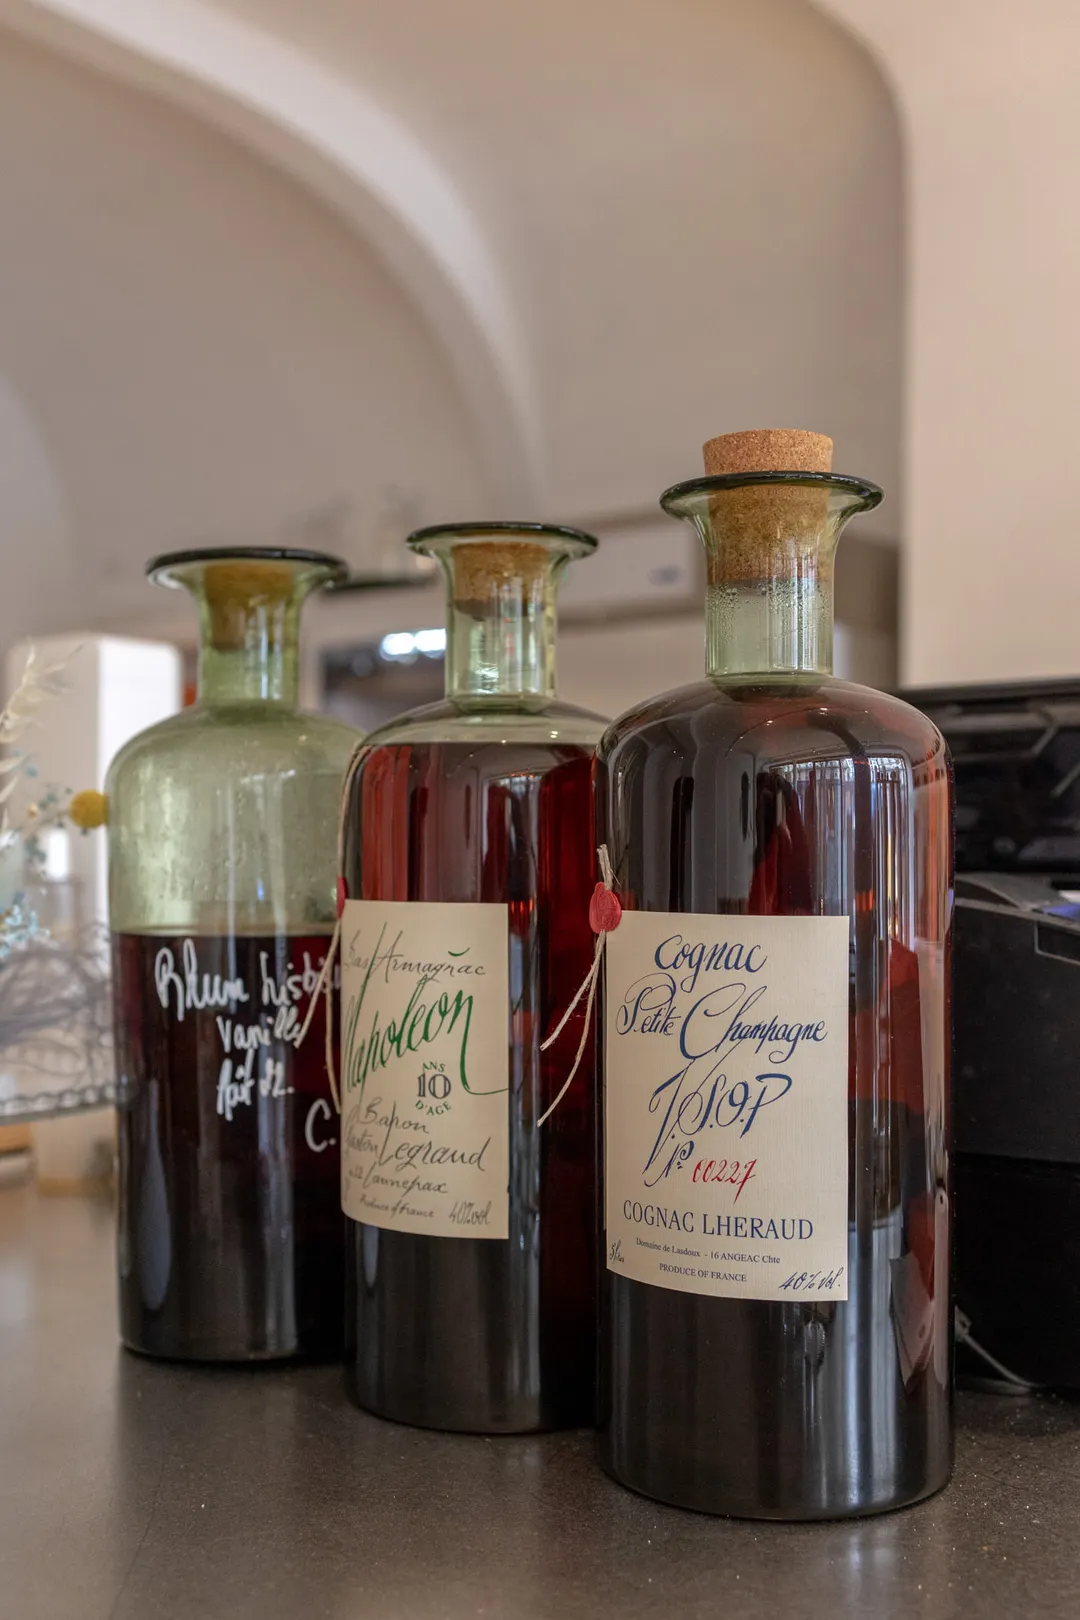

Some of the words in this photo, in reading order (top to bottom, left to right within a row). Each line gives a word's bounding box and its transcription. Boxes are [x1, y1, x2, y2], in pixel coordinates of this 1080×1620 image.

[654, 934, 768, 993] Cognac
[616, 972, 681, 1035] Petite
[679, 982, 828, 1064] Champagne
[422, 1061, 446, 1073] ANS
[417, 1072, 452, 1100] 10
[360, 1096, 430, 1134] Baron
[692, 1158, 758, 1206] 00227
[623, 1199, 694, 1233] COGNAC
[702, 1213, 814, 1241] LHERAUD
[636, 1237, 661, 1251] Domaine
[662, 1244, 670, 1252] de
[672, 1246, 701, 1258] Lasdoux
[710, 1251, 720, 1260] 16
[720, 1252, 760, 1264] ANGEAC
[659, 1262, 696, 1277] PRODUCE
[697, 1269, 710, 1278] OF
[711, 1271, 747, 1283] FRANCE
[778, 1271, 821, 1291] 40%
